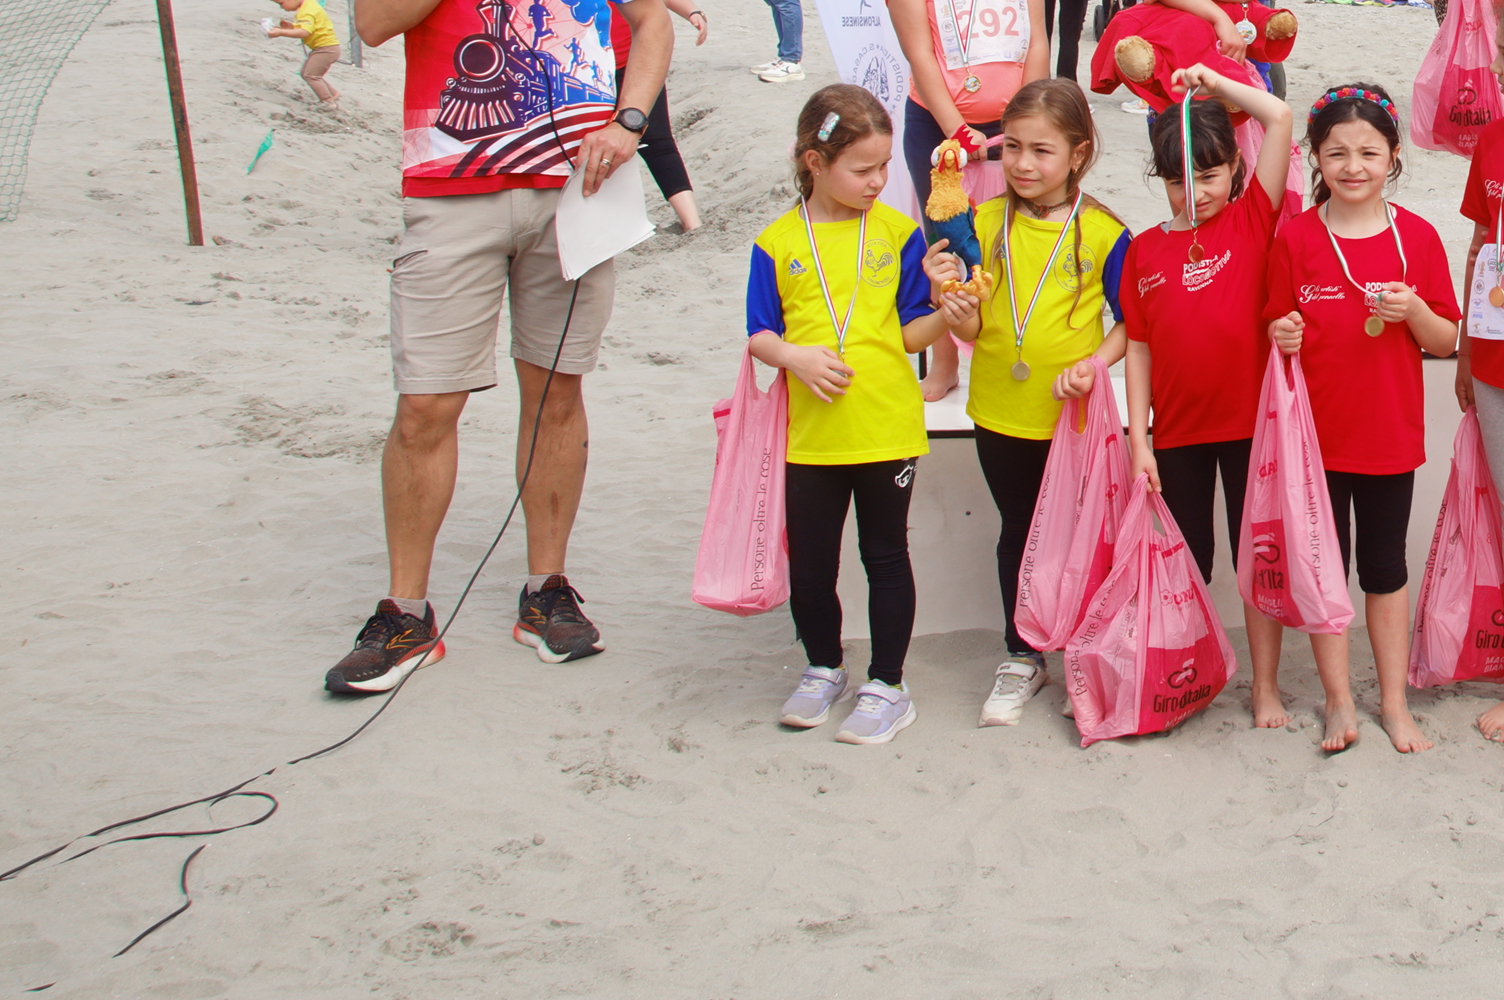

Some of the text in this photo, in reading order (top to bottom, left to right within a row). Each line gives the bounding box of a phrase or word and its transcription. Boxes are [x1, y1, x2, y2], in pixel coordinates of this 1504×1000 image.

[956, 6, 1020, 40] 292
[1182, 249, 1232, 286] LOCOMOTIVA
[1183, 255, 1219, 274] PODISTIA
[1187, 278, 1214, 292] RAVENNA
[1303, 473, 1314, 486] le
[750, 448, 771, 592] Persone oltre le cose
[1305, 492, 1319, 526] oltre
[1427, 548, 1438, 579] oltre
[1433, 531, 1441, 543] le
[1019, 555, 1036, 608] Persone
[1255, 567, 1285, 590] d'Ita
[1258, 603, 1284, 617] BIANC
[1069, 649, 1088, 697] Persone
[1093, 607, 1104, 623] le
[1475, 629, 1500, 649] Giro
[1153, 684, 1212, 713] Giro dtalia
